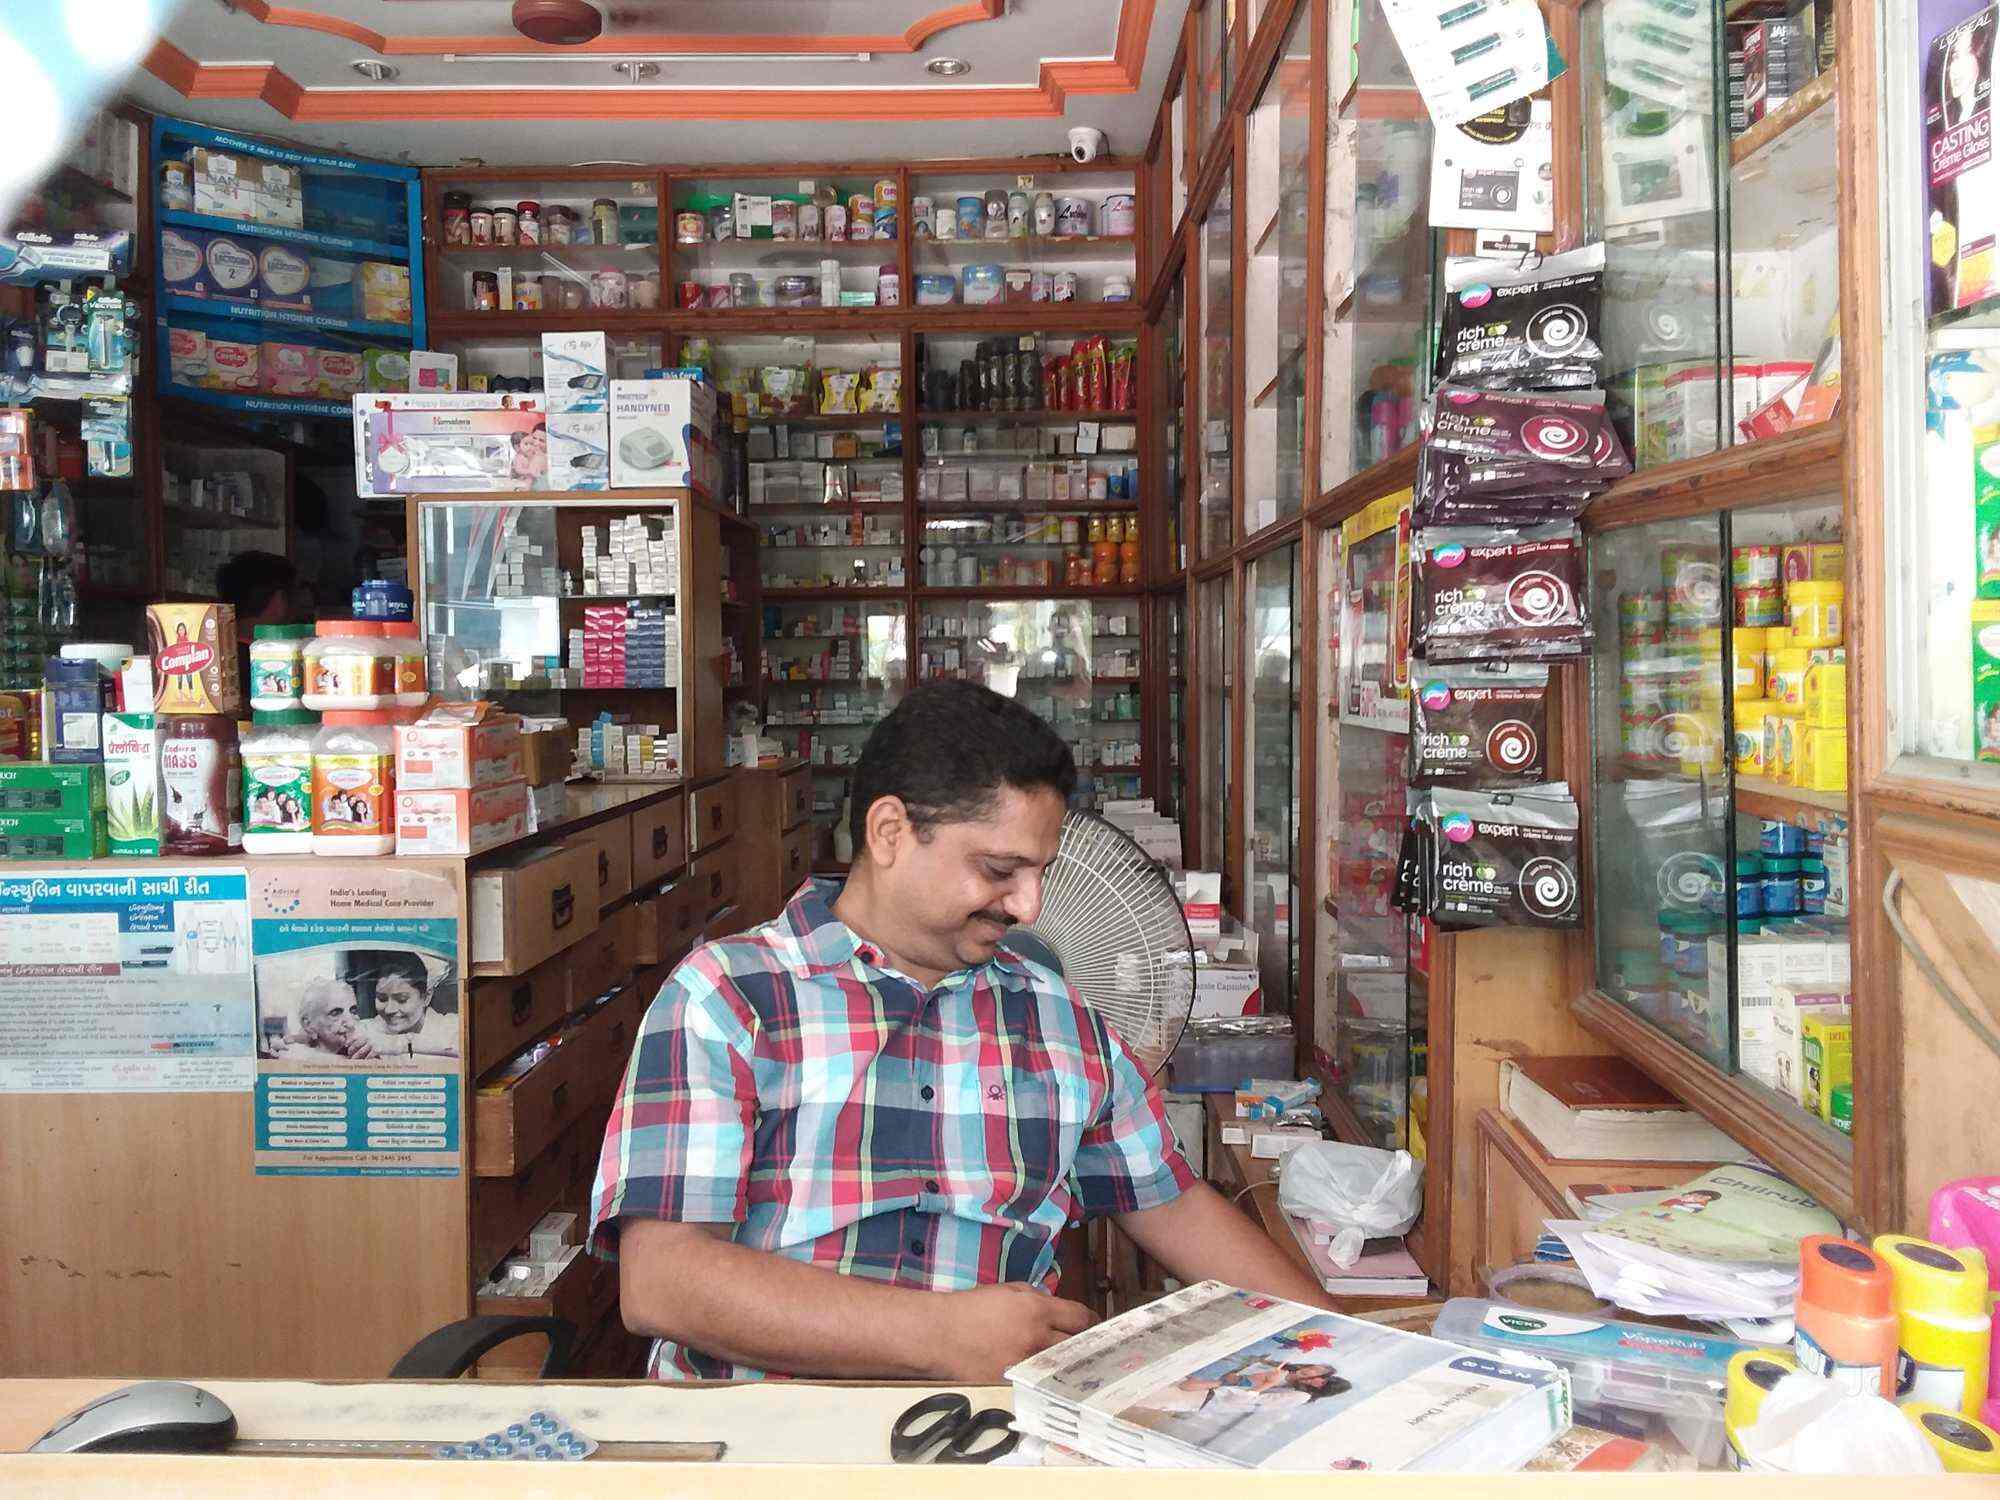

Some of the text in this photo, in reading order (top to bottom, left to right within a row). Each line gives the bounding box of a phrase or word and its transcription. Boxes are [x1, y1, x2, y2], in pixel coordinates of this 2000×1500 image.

[1932, 115, 1990, 160] CASTING
[1962, 137, 1990, 159] Gloss
[236, 223, 284, 236] NUTRITION
[16, 232, 53, 244] Gillette
[228, 268, 237, 279] 2
[1496, 282, 1539, 297] expert
[230, 306, 278, 321] NUTRITION
[1457, 325, 1485, 341] rich
[244, 400, 293, 412] NUTRITION
[616, 402, 671, 413] HANDYNEB
[1439, 411, 1471, 426] rich
[1470, 545, 1513, 560] expert
[1434, 587, 1463, 604] rich
[161, 644, 210, 672] Complan
[1453, 688, 1493, 702] expert
[1420, 732, 1450, 746] rich
[163, 754, 198, 769] MASS
[1478, 823, 1519, 838] expert
[1442, 861, 1473, 878] rich
[0, 879, 61, 903] ન્સ્યુલિન
[142, 876, 180, 896] સાચી
[1442, 875, 1494, 894] crème
[330, 888, 388, 898] India's Leading
[330, 899, 351, 908] Home
[353, 899, 383, 908] Medical
[403, 899, 435, 908] Provider
[1216, 982, 1251, 992] Capsules
[1501, 1317, 1545, 1330] VICKS
